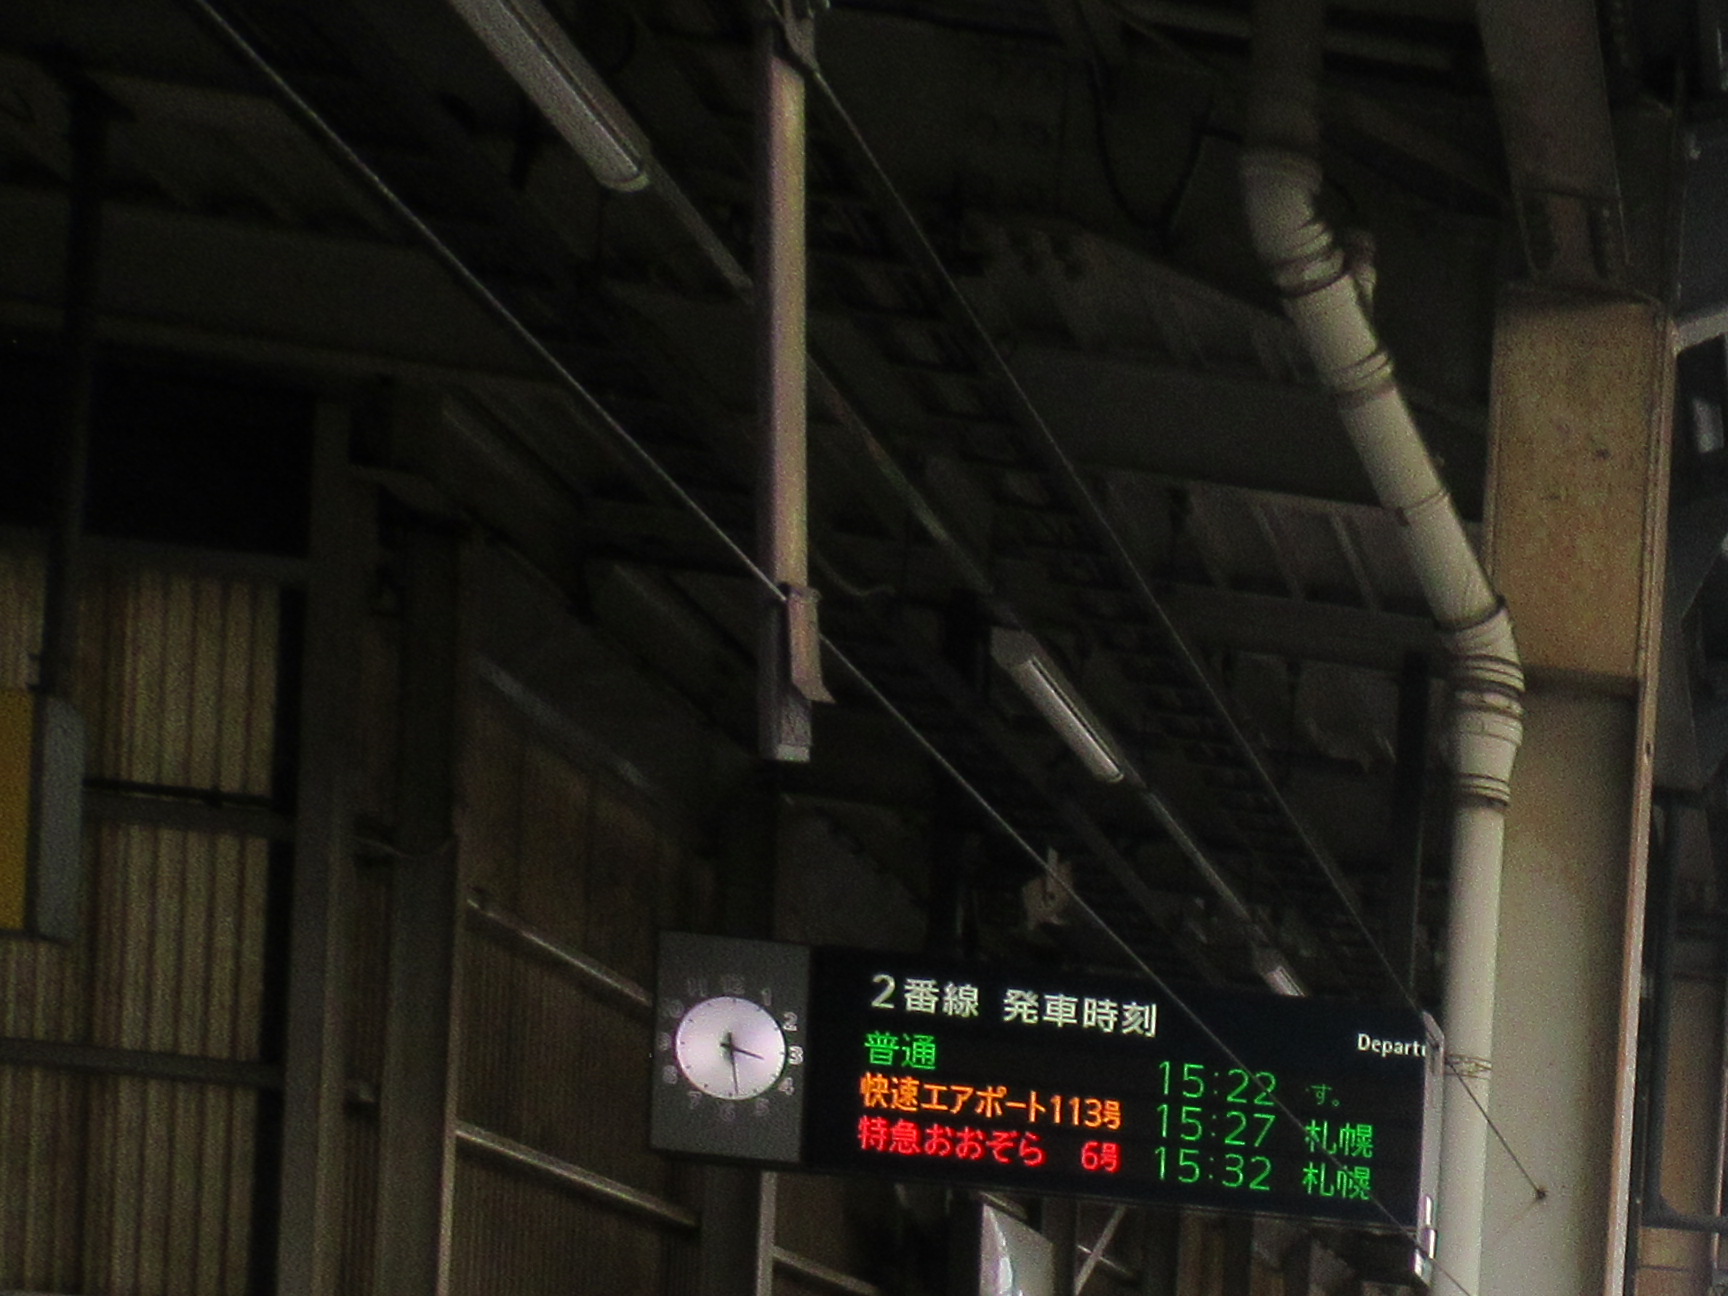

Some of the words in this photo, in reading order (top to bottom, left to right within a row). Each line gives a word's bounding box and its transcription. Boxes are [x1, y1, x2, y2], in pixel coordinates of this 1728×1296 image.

[782, 1011, 799, 1032] 2
[871, 973, 980, 1018] 2番線
[1003, 988, 1157, 1038] 発車時刻
[788, 1045, 804, 1066] 3
[864, 1030, 937, 1071] 普通
[1159, 1060, 1277, 1107] 15:22
[860, 1071, 1122, 1131] 快速エアポート113号
[1157, 1103, 1277, 1148] 15:27
[1304, 1119, 1374, 1159] 札幌
[858, 1115, 1047, 1168] 特急おおぞら
[1080, 1140, 1122, 1173] 6号
[1154, 1145, 1271, 1191] 15:32
[1302, 1160, 1372, 1201] 札幌
